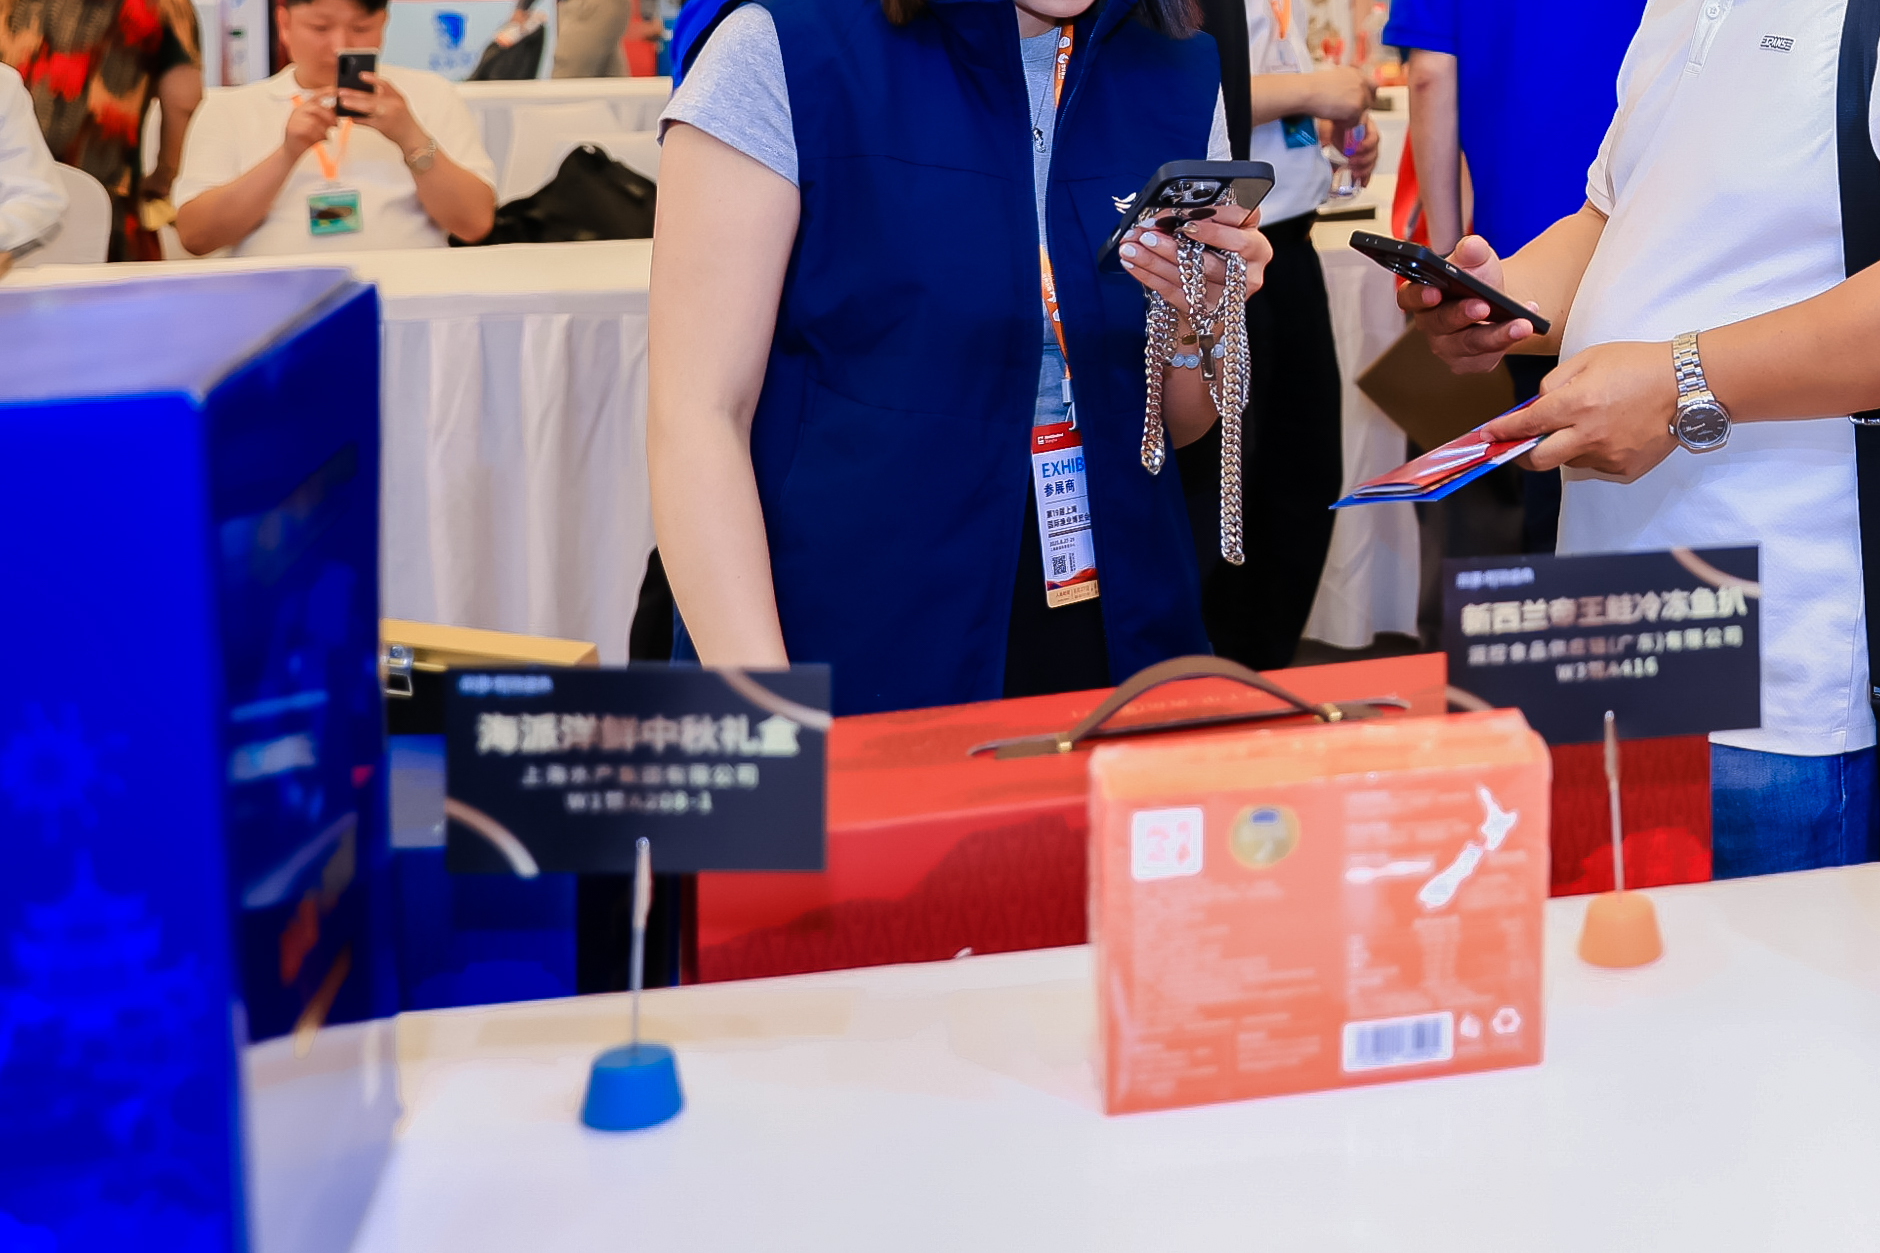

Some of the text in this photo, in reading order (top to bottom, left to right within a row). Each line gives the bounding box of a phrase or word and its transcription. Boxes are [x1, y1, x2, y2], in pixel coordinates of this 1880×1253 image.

[1044, 479, 1075, 497] 参展商
[477, 713, 800, 757] 海派洋鲜中秋礼盒
